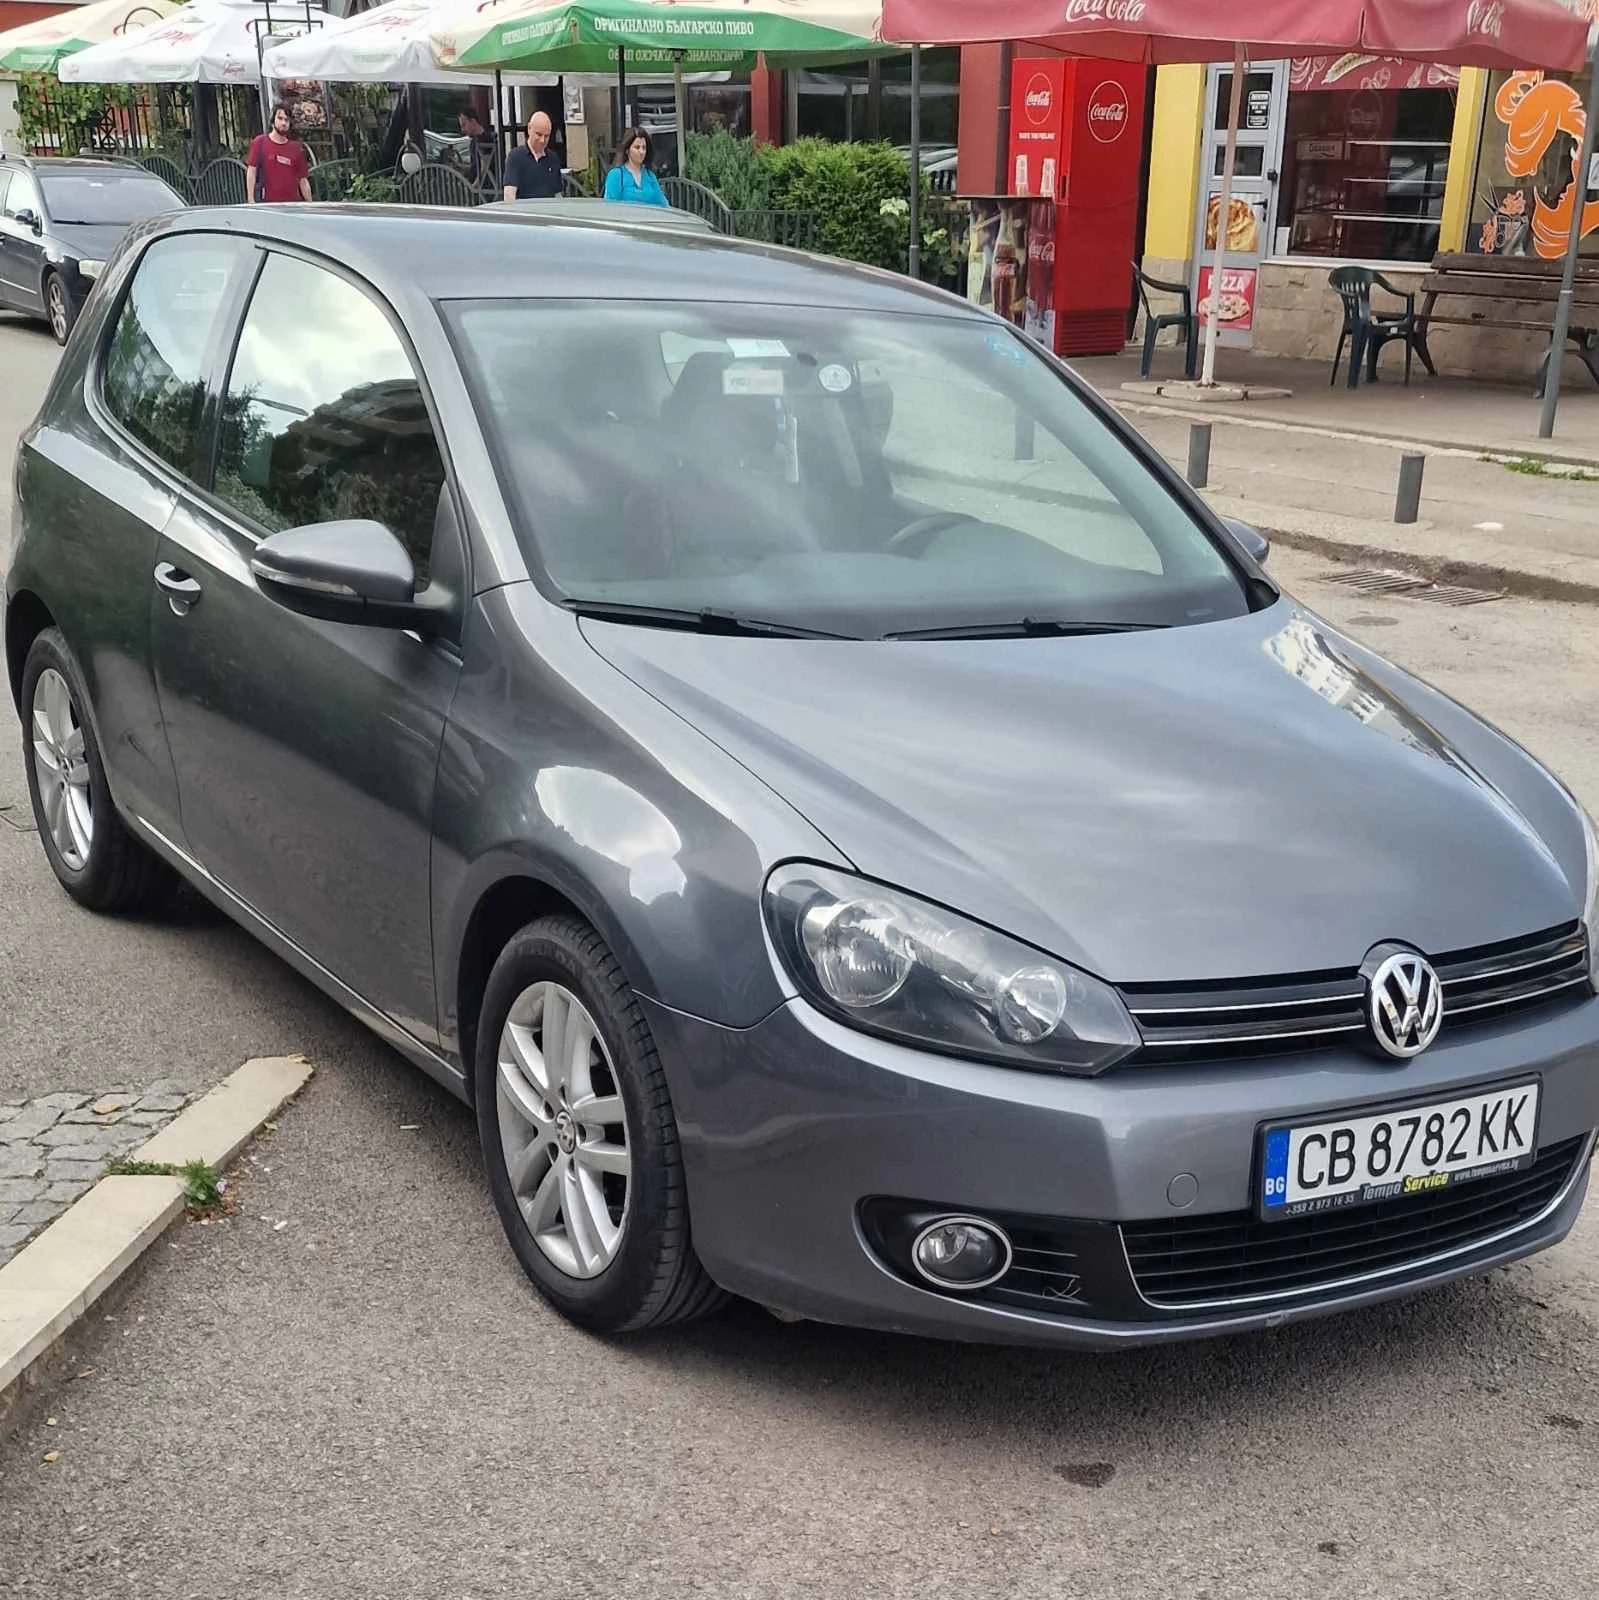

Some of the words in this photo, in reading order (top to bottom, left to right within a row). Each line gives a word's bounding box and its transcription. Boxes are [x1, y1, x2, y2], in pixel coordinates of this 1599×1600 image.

[594, 17, 664, 33] ОРИГИНАЛНО
[665, 20, 723, 35] БЪЛГАРСКО
[725, 21, 754, 35] ПИВО
[1297, 1128, 1356, 1190] CB
[1366, 1107, 1471, 1178] 8782
[1477, 1094, 1529, 1156] KK
[1265, 1175, 1286, 1197] BG
[1362, 1182, 1401, 1200] Tempo
[1403, 1172, 1449, 1193] Service
